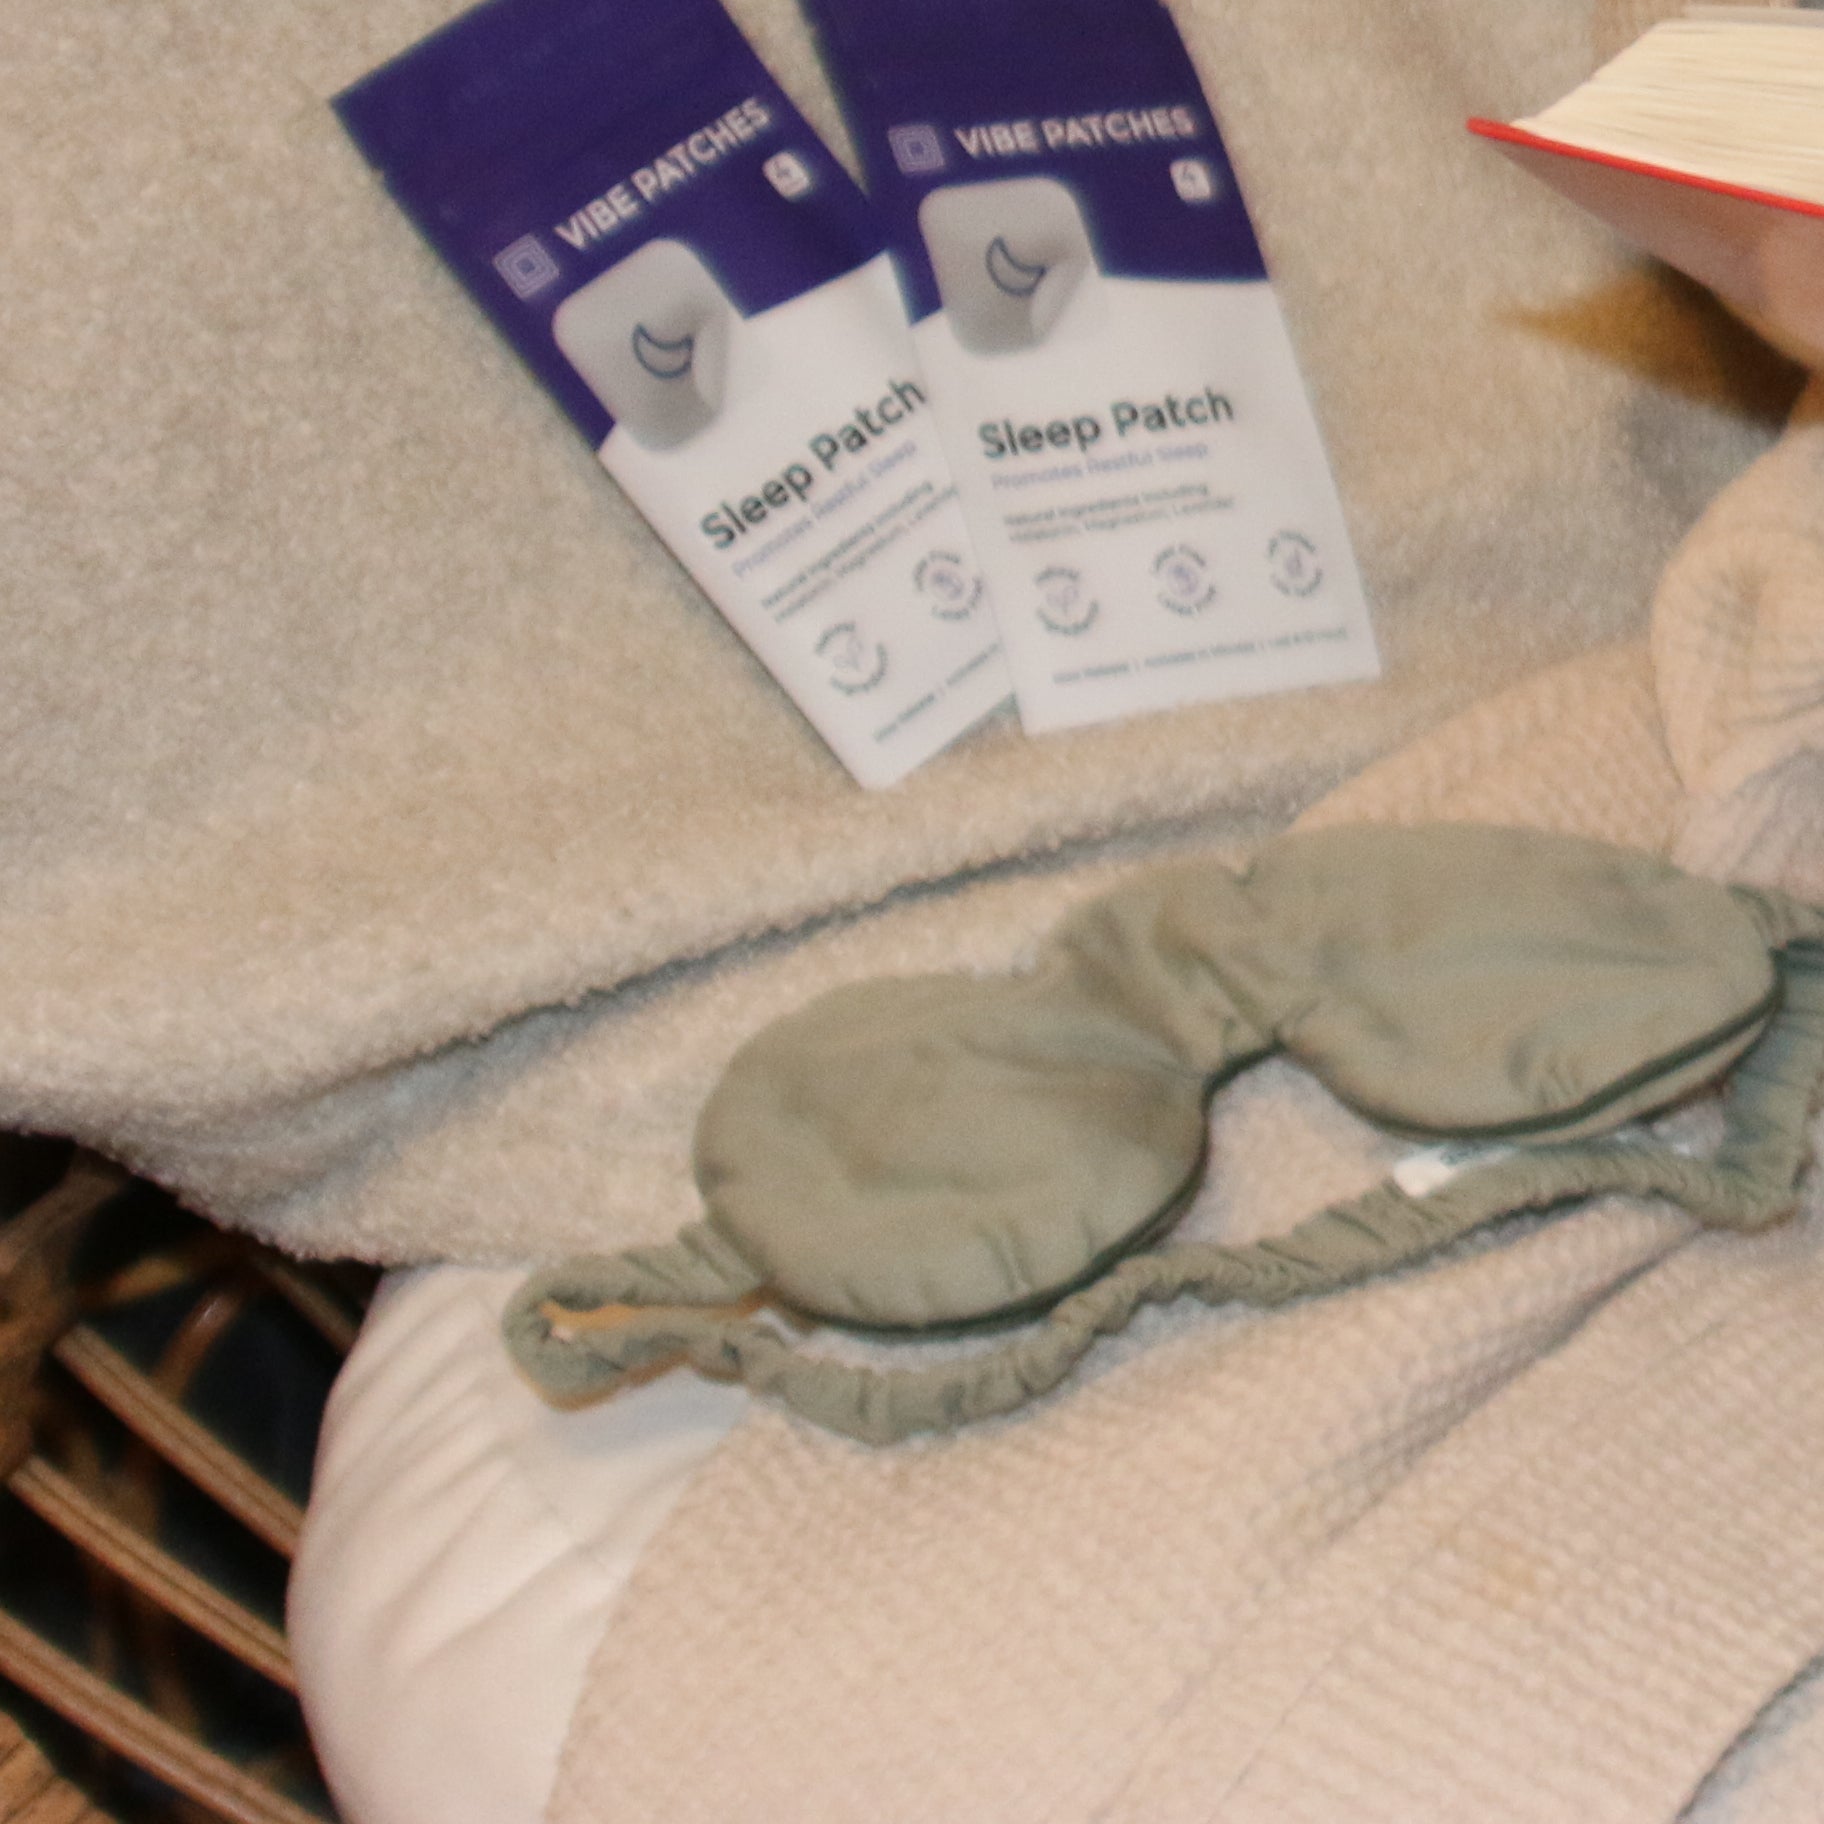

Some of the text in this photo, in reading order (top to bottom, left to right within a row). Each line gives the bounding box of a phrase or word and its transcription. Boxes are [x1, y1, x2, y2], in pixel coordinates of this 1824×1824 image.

[553, 94, 773, 252] VIBE PATCHES
[954, 104, 1197, 160] VIBE PATCHES
[700, 377, 928, 551] Sleep Patch
[978, 385, 1235, 461] Sleep Patch
